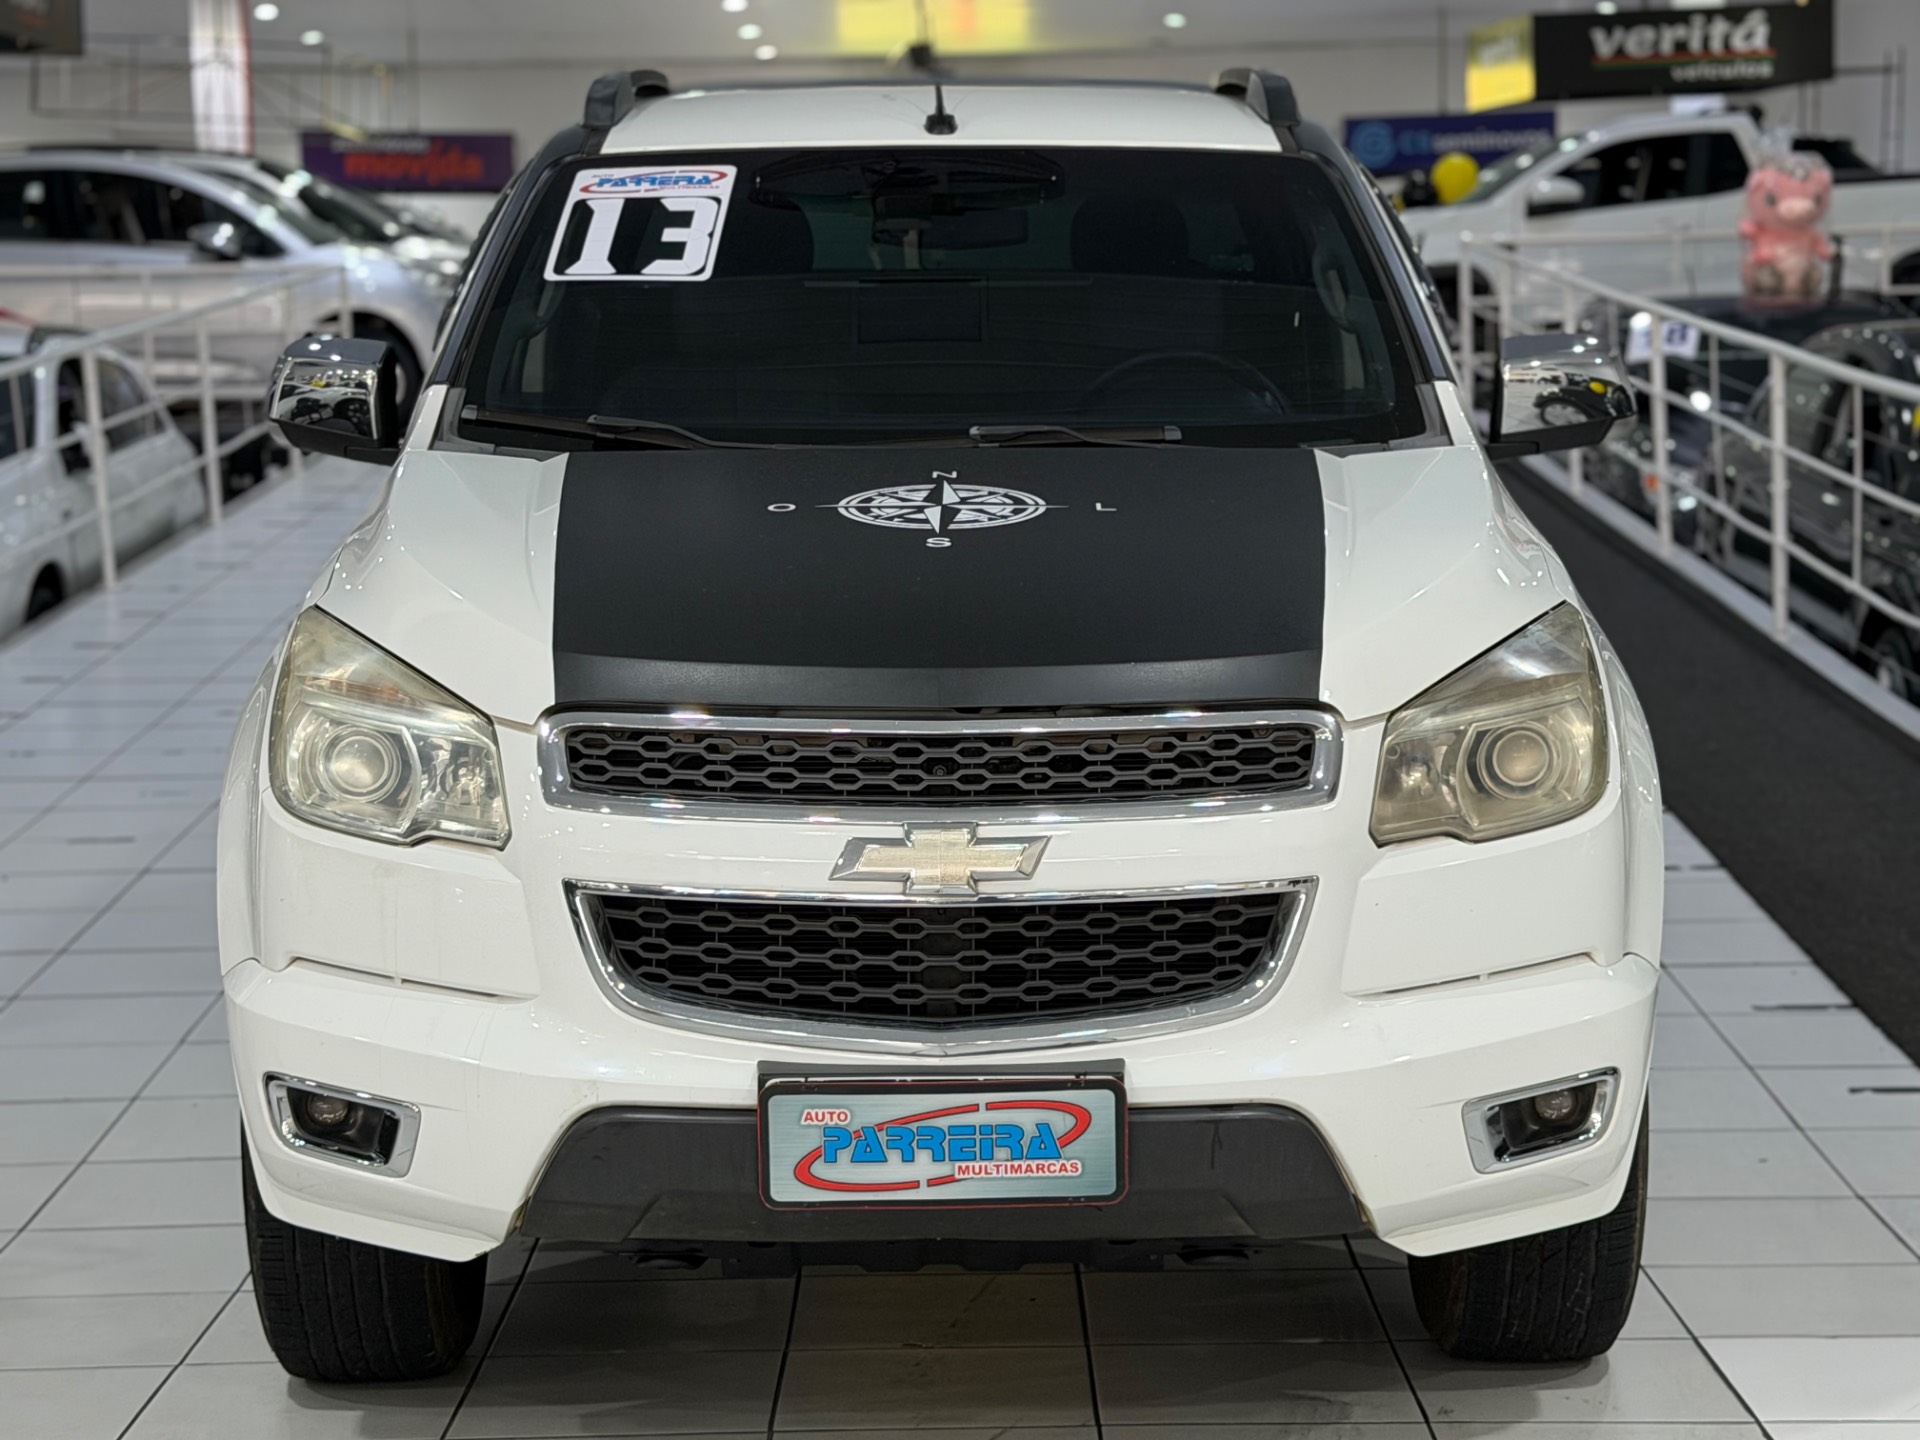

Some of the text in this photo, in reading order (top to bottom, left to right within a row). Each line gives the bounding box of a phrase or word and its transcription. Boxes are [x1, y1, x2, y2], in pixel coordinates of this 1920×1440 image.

[564, 198, 719, 275] 13
[932, 470, 957, 479] N
[767, 503, 796, 512] O
[1095, 502, 1117, 512] L
[925, 537, 952, 548] S
[803, 1110, 849, 1124] AUTO
[822, 1123, 1063, 1163] PARREIRA
[956, 1162, 1080, 1176] MULTIMARCAS
